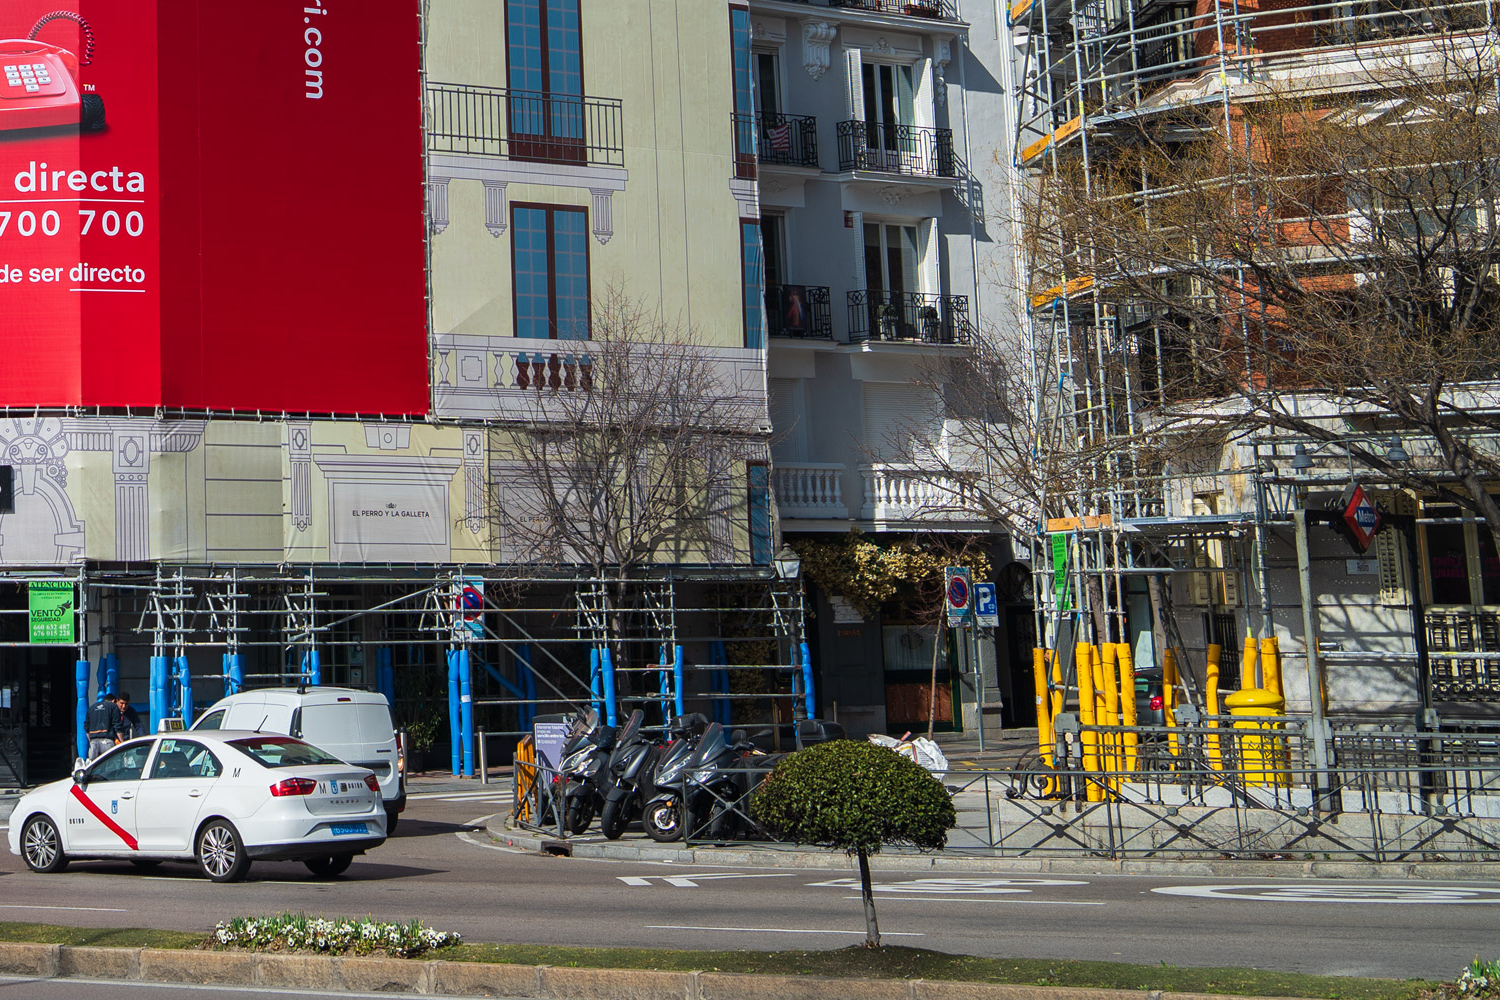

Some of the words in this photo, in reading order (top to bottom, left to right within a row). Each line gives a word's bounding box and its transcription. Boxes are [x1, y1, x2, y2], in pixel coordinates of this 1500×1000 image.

[14, 160, 145, 193] directa
[78, 210, 144, 237] 700
[29, 267, 64, 283] ser
[68, 262, 146, 283] directo
[352, 509, 361, 517] EL
[401, 510, 430, 518] GALLETA
[1358, 509, 1375, 524] Metro
[978, 587, 991, 611] P
[232, 768, 241, 778] M
[319, 783, 327, 794] M
